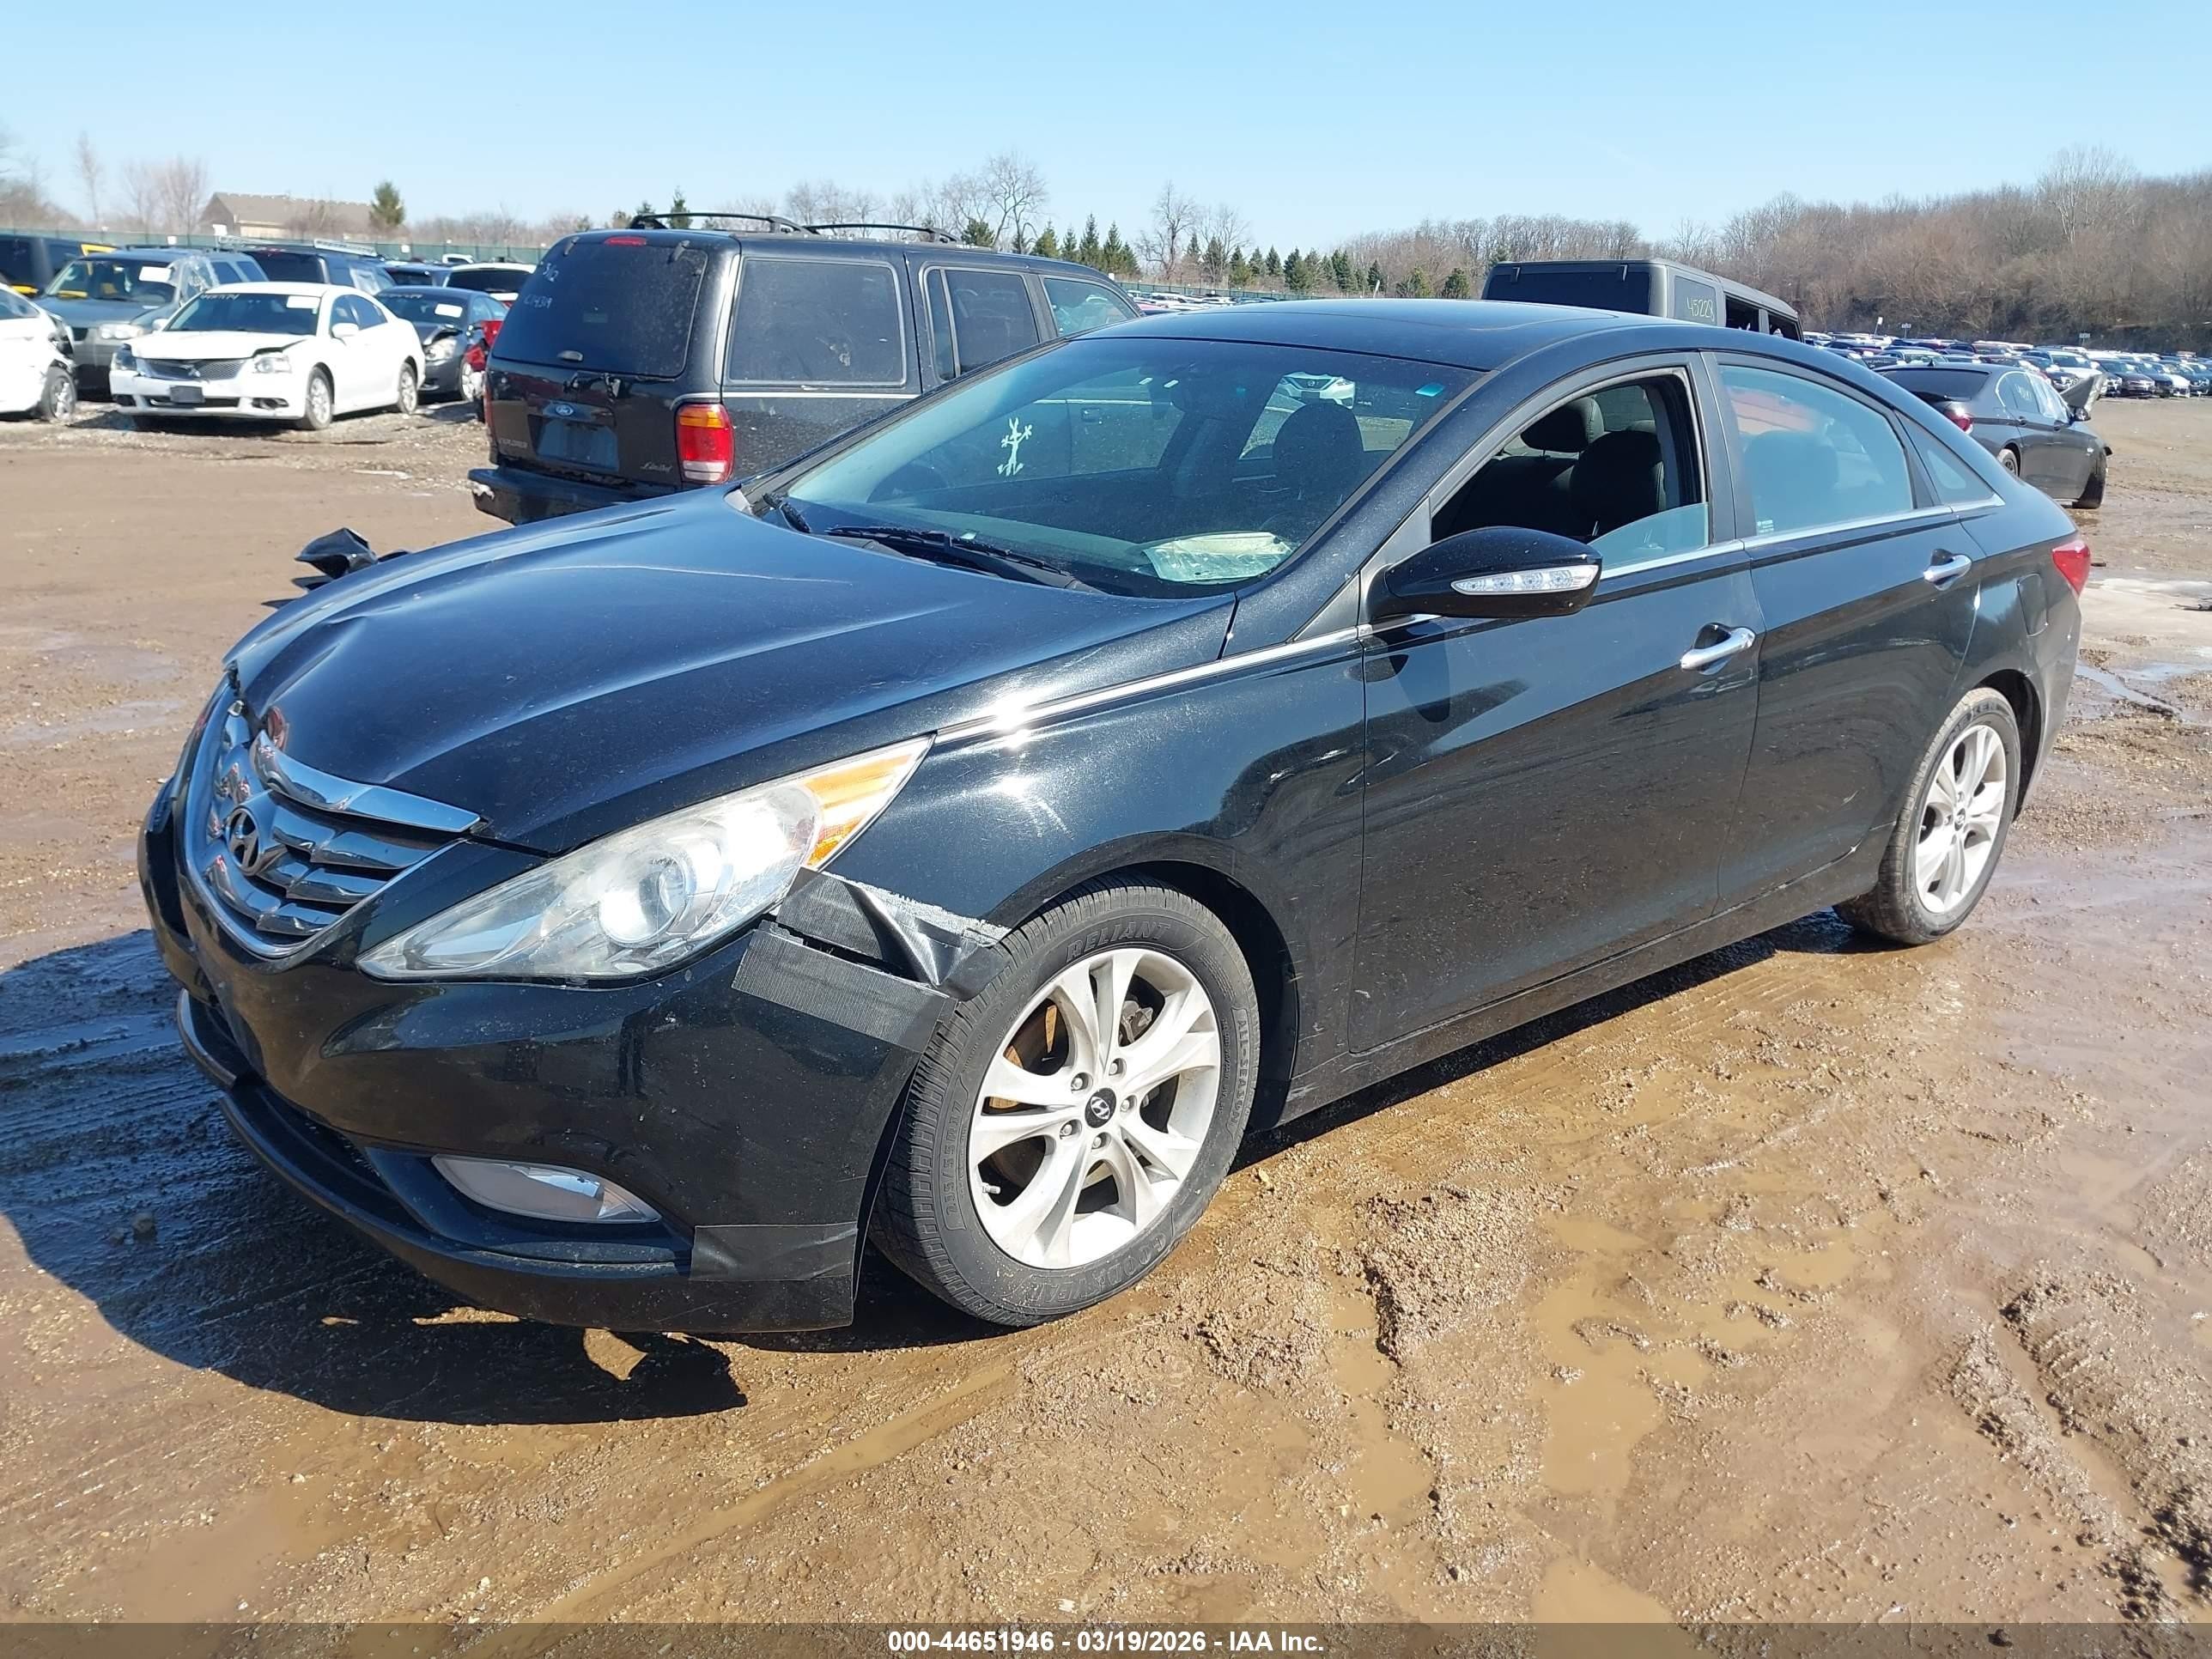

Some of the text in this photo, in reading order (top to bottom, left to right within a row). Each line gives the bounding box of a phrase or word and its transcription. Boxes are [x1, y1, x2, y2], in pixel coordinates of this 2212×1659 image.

[1686, 296, 1715, 322] 45228
[1066, 921, 1171, 963] RELIANT
[1229, 1019, 1249, 1127] ALL-SEASON
[1027, 1233, 1166, 1303] GOODYEAR
